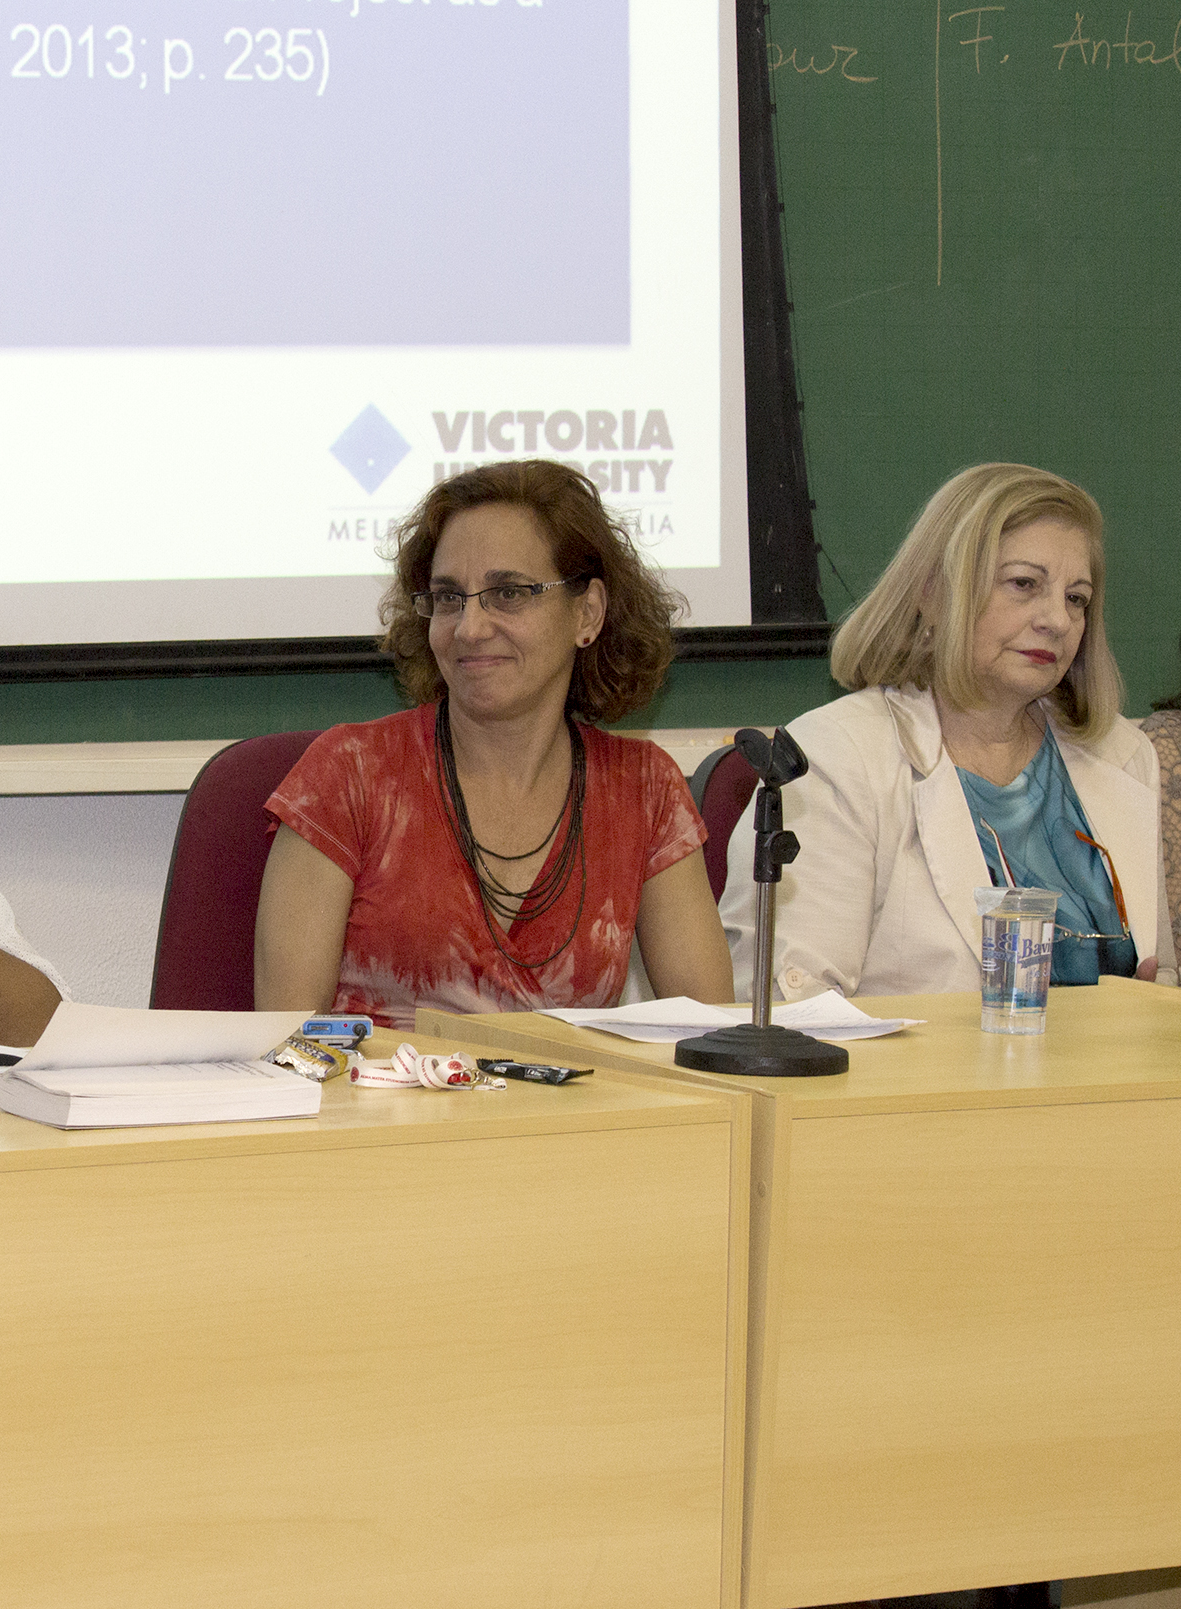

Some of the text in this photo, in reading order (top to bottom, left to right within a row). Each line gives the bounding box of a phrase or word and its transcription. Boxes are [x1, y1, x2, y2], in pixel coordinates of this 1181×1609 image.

[10, 22, 147, 89] 2013;
[163, 37, 206, 93] p.
[223, 27, 330, 96] 235)
[431, 409, 674, 453] VICTORIA
